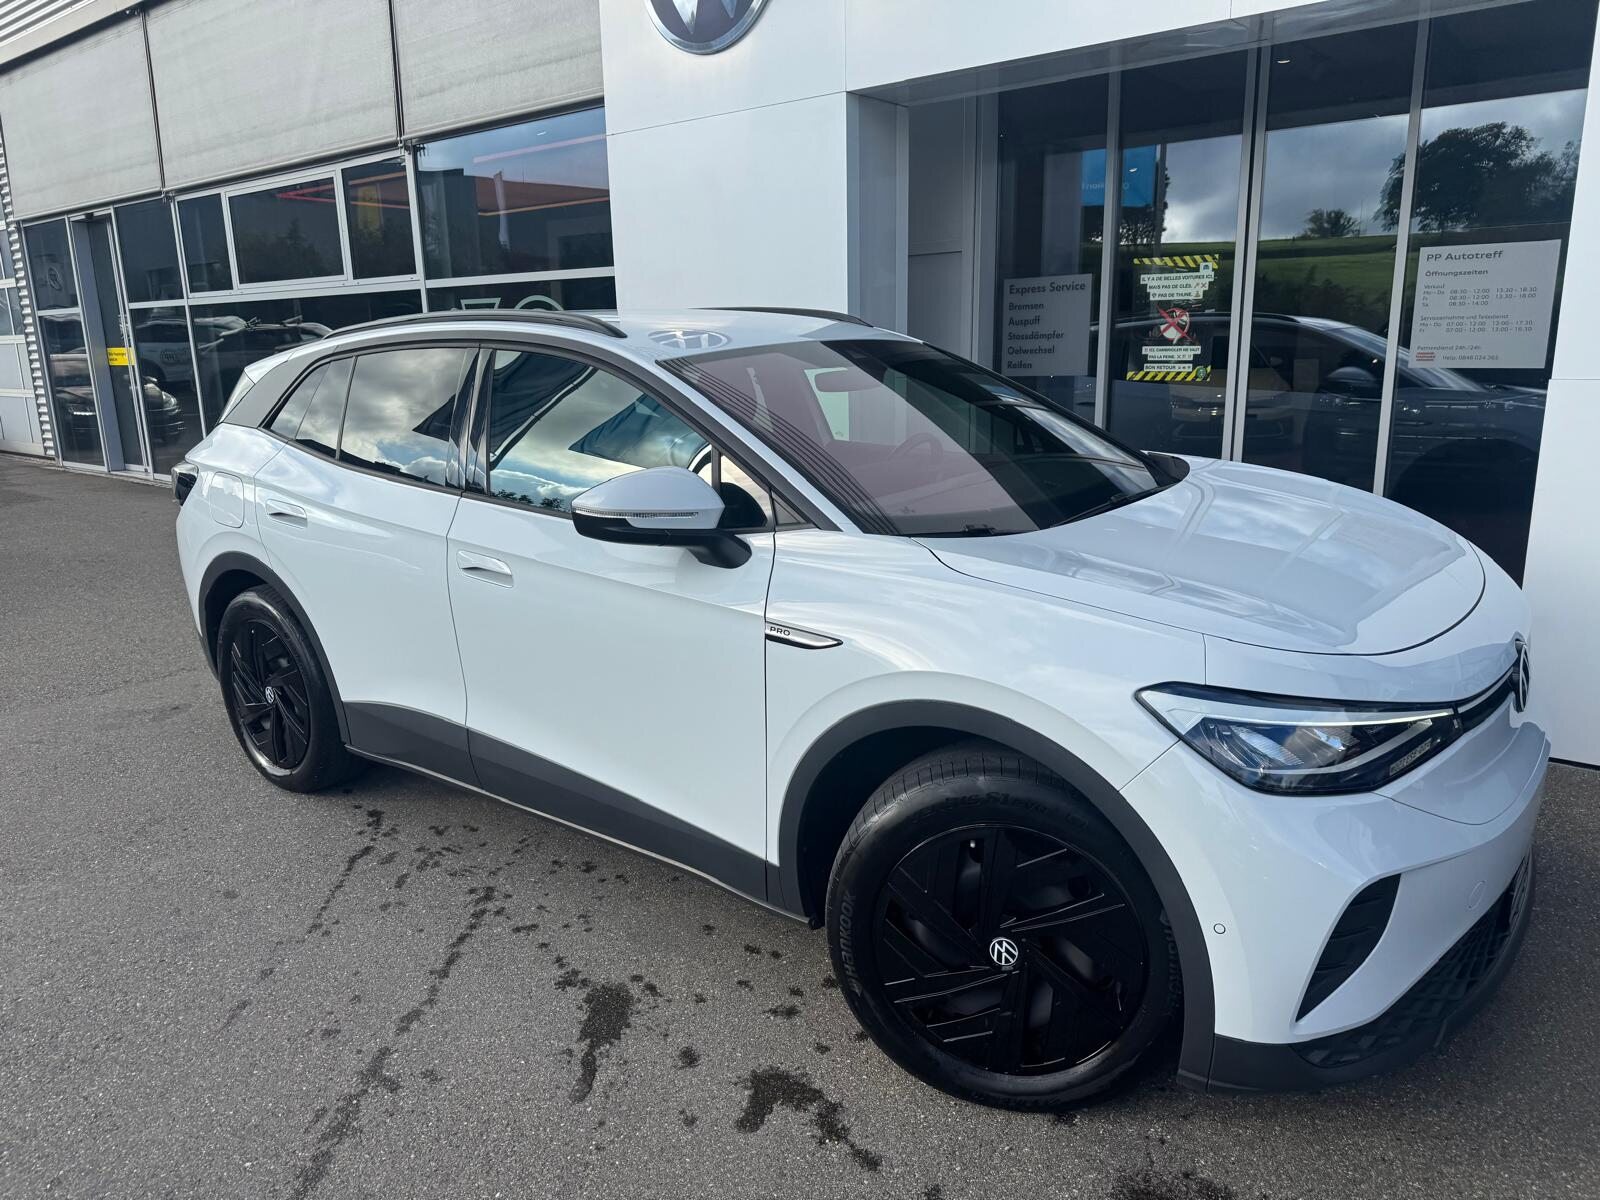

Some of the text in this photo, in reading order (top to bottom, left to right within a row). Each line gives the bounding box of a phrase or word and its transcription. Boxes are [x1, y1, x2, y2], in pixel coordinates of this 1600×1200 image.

[1426, 250, 1504, 261] PP Autotreff
[1424, 269, 1489, 278] Öffnungszeiten
[1009, 281, 1086, 297] Express Service
[1008, 302, 1044, 311] Bremsen
[1008, 315, 1041, 327] Auspuff
[1007, 330, 1065, 341] Stossdämpfer
[1007, 345, 1055, 355] Oelwechsel
[1007, 360, 1033, 369] Reifen
[770, 626, 791, 636] PRO
